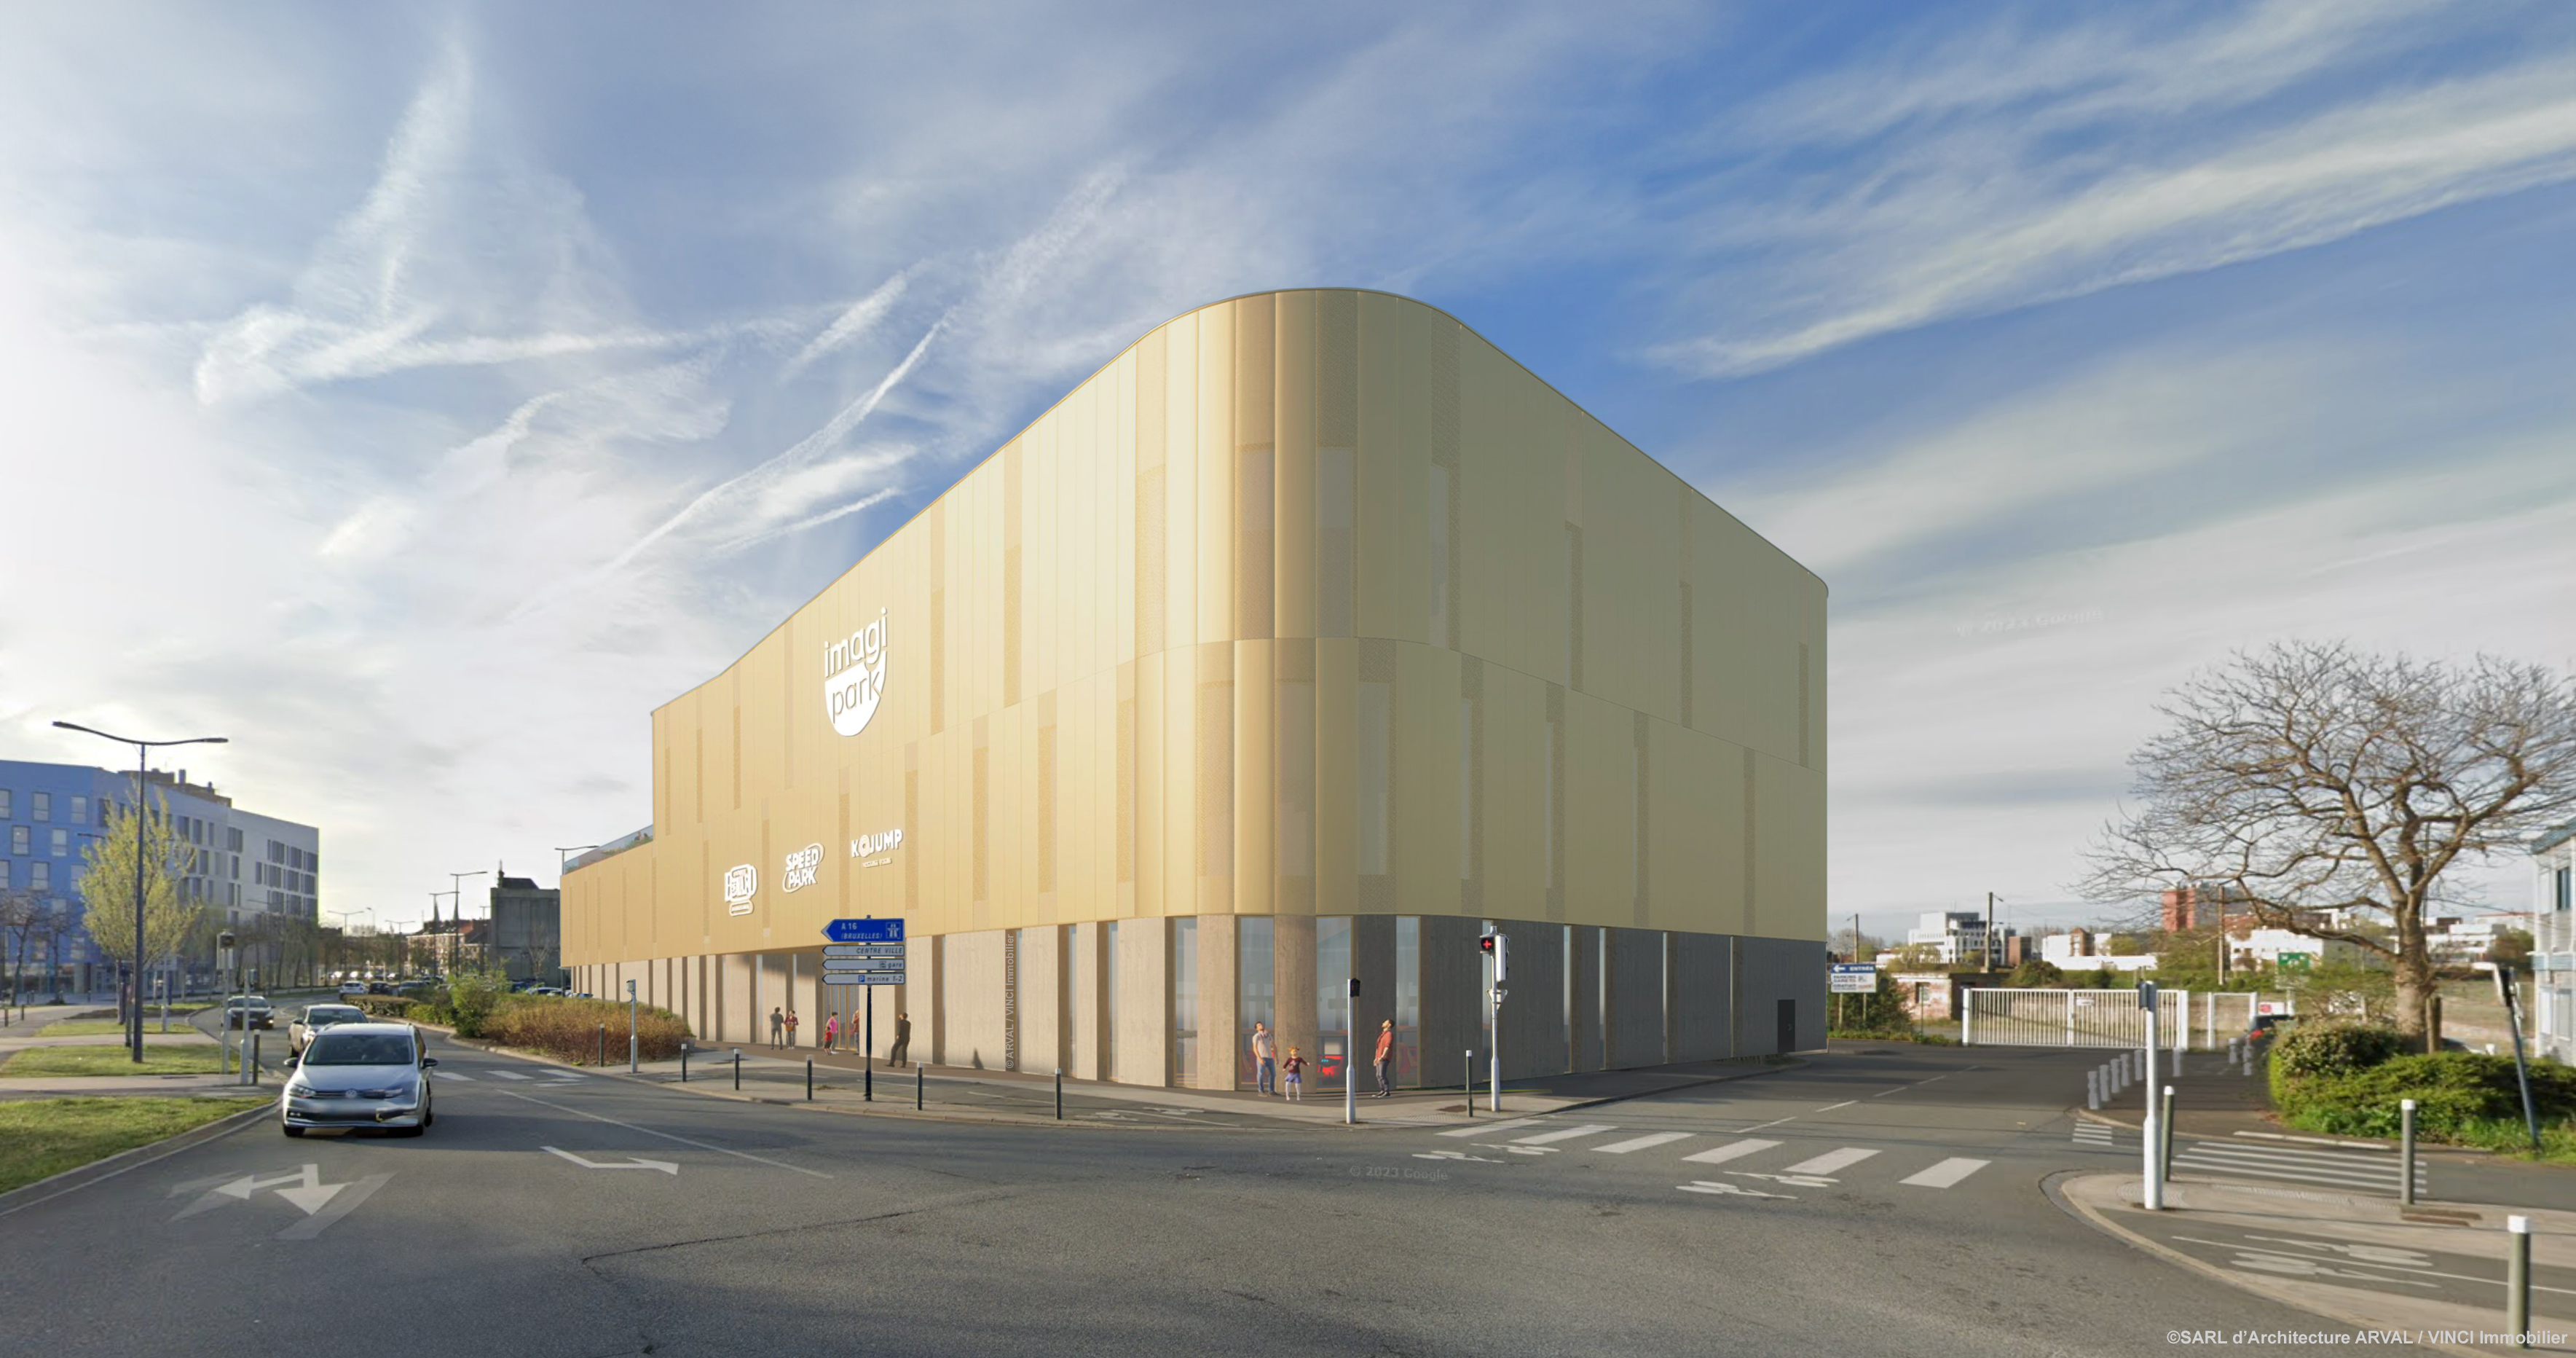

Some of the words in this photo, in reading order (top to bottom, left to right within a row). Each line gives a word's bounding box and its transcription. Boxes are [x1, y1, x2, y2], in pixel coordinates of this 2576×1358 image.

[824, 607, 887, 678] imagi
[832, 670, 881, 724] park
[786, 849, 819, 871] SPEED
[789, 867, 818, 887] PARK
[848, 922, 857, 930] 16
